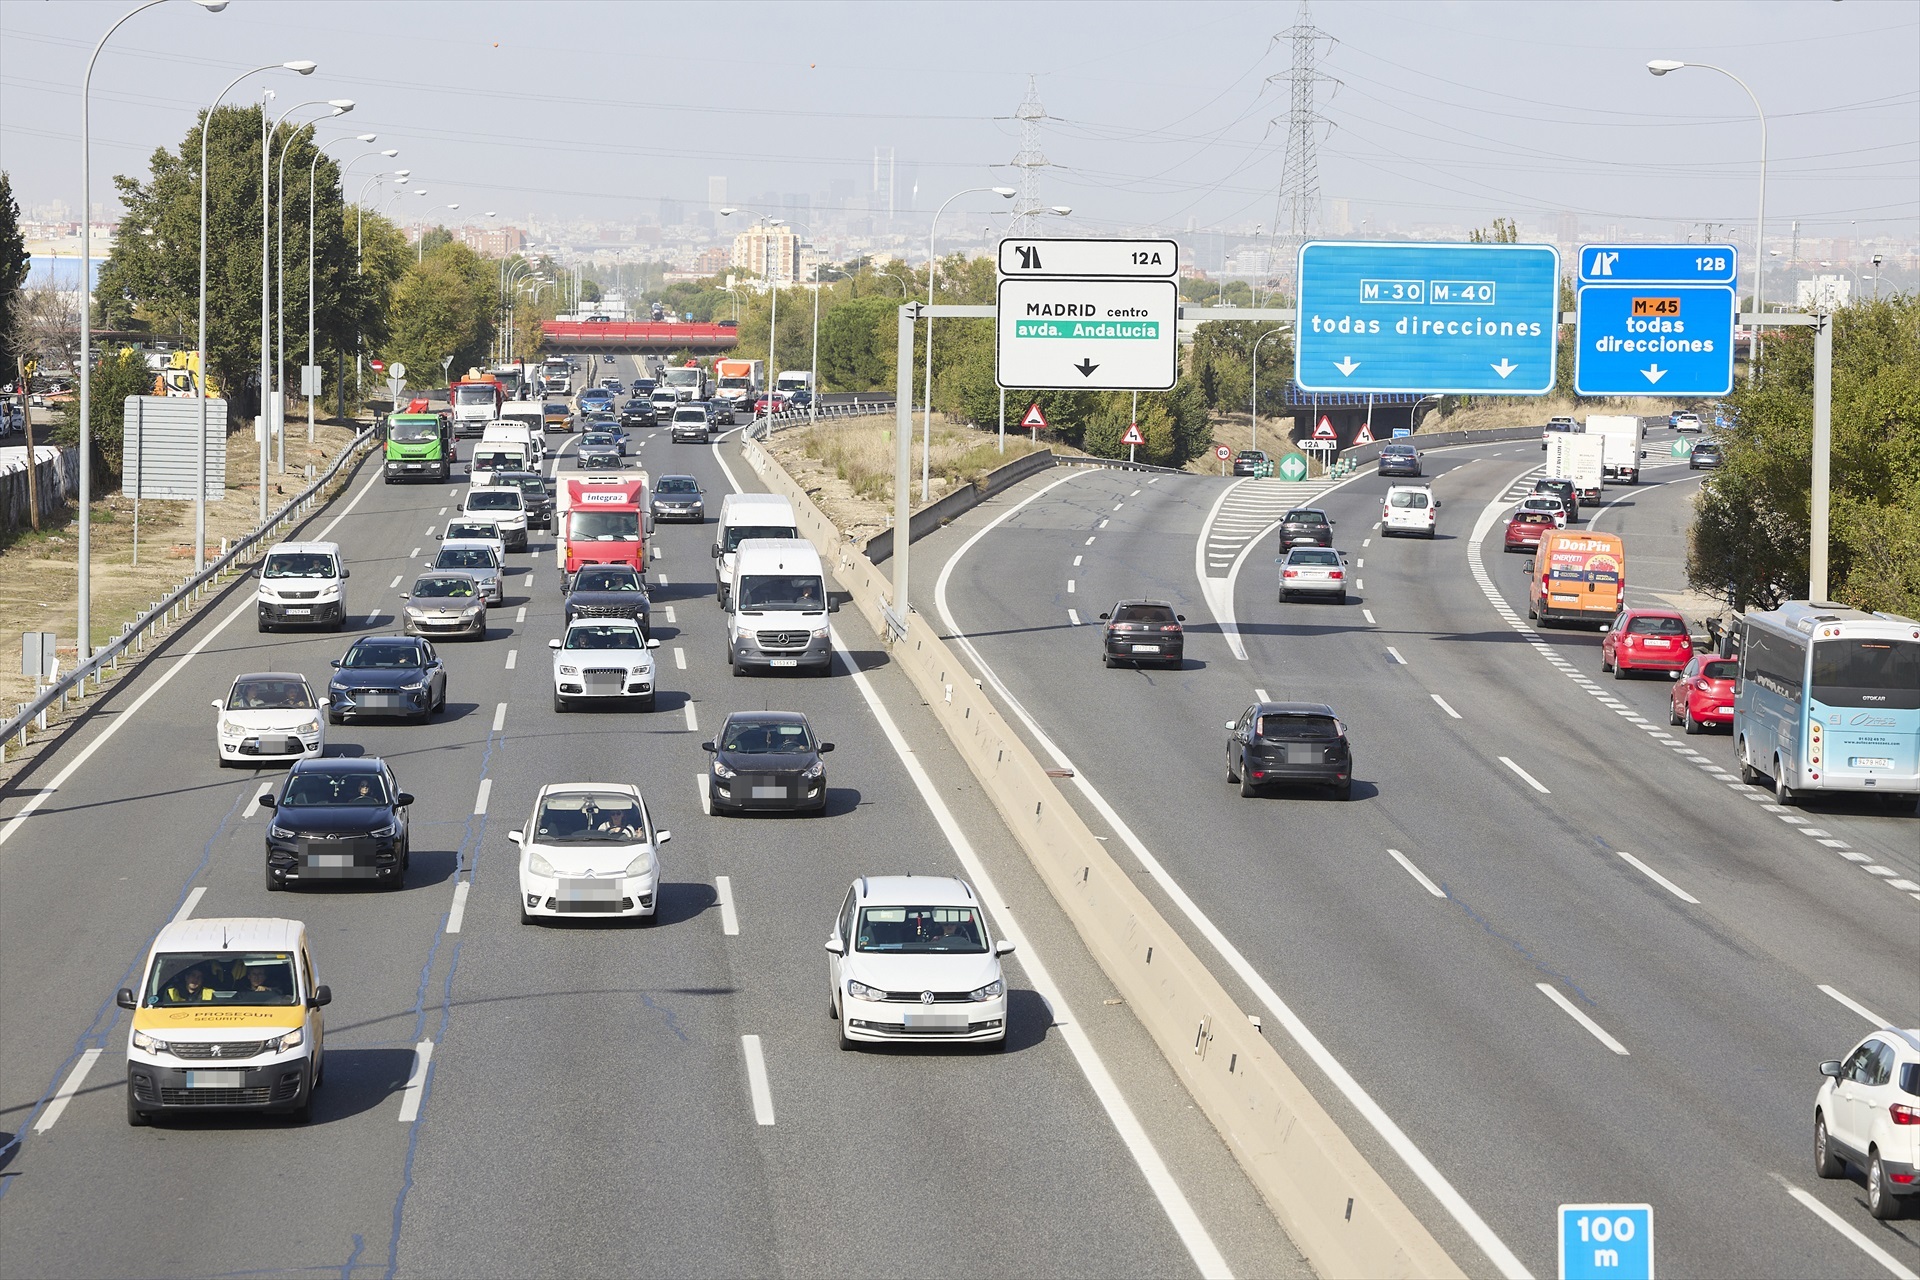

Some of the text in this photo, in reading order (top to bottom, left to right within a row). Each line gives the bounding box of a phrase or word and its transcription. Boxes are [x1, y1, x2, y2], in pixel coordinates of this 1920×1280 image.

[1132, 252, 1162, 265] 12A
[1695, 257, 1726, 271] 12B
[1364, 284, 1420, 299] M-30
[1434, 285, 1492, 301] M-40
[1026, 303, 1148, 317] MADRID centro
[1634, 300, 1678, 314] M-45
[1018, 323, 1156, 337] avda. Andalucía
[1311, 314, 1541, 336] todas direcciones
[1626, 316, 1684, 333] todas
[1595, 335, 1714, 353] direcciones
[587, 493, 623, 503] integra2
[1558, 538, 1611, 552] DonPin
[1577, 1216, 1635, 1242] 100
[1594, 1248, 1619, 1267] m
